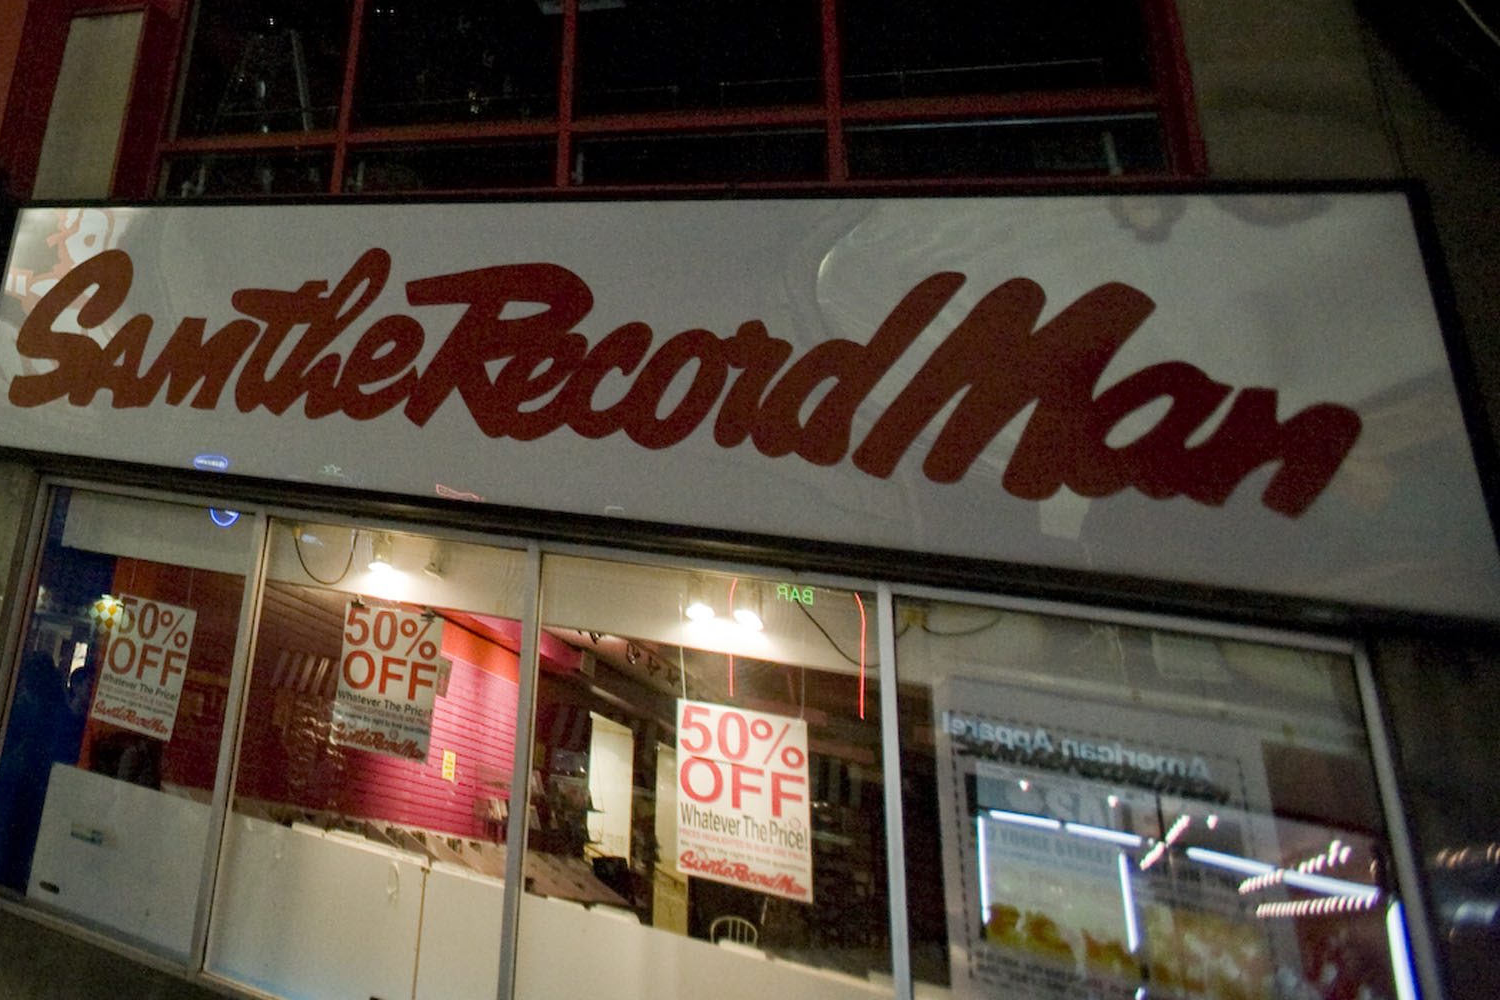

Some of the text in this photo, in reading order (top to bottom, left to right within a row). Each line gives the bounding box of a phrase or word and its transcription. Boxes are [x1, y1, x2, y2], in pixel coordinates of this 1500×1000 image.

[118, 599, 188, 649] 50%
[345, 607, 437, 660] 50%
[108, 637, 187, 687] OFF
[343, 650, 437, 701] OFF
[338, 690, 381, 708] Whatever
[384, 699, 401, 712] The
[680, 704, 805, 769] 50%
[680, 756, 805, 818] OFF
[680, 802, 741, 836] Whatever
[742, 815, 767, 843] The
[769, 820, 808, 851] Price!
